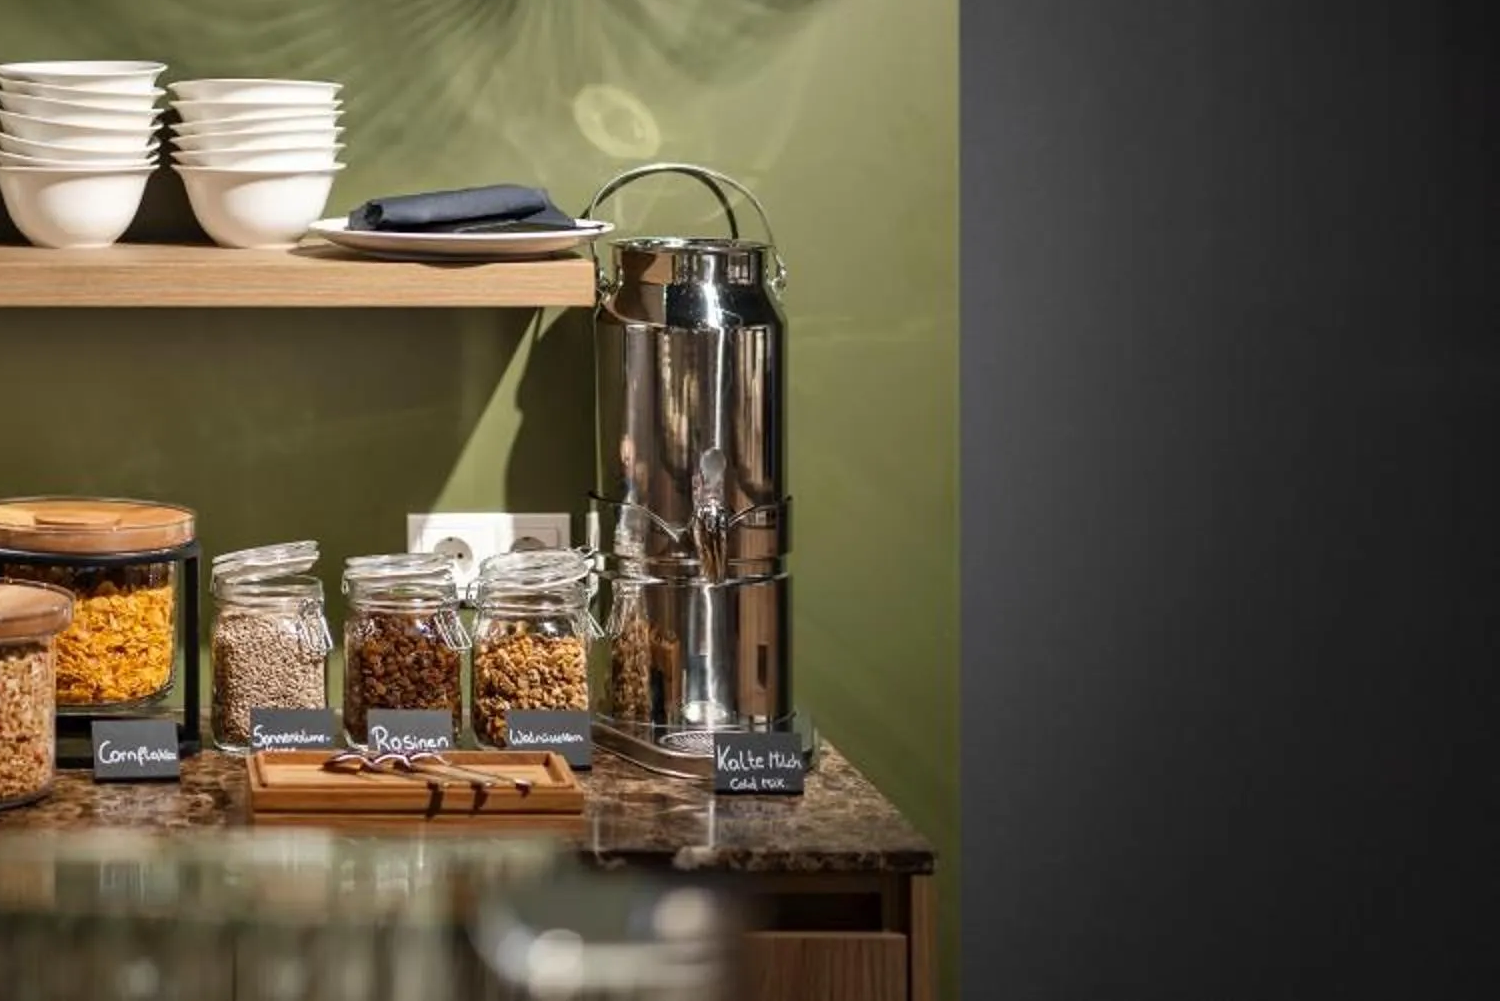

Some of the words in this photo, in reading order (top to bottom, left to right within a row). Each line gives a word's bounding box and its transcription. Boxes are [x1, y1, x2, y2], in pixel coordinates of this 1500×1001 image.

[371, 726, 449, 751] Rosinen
[717, 744, 764, 771] Kalte
[729, 776, 758, 791] Cold
